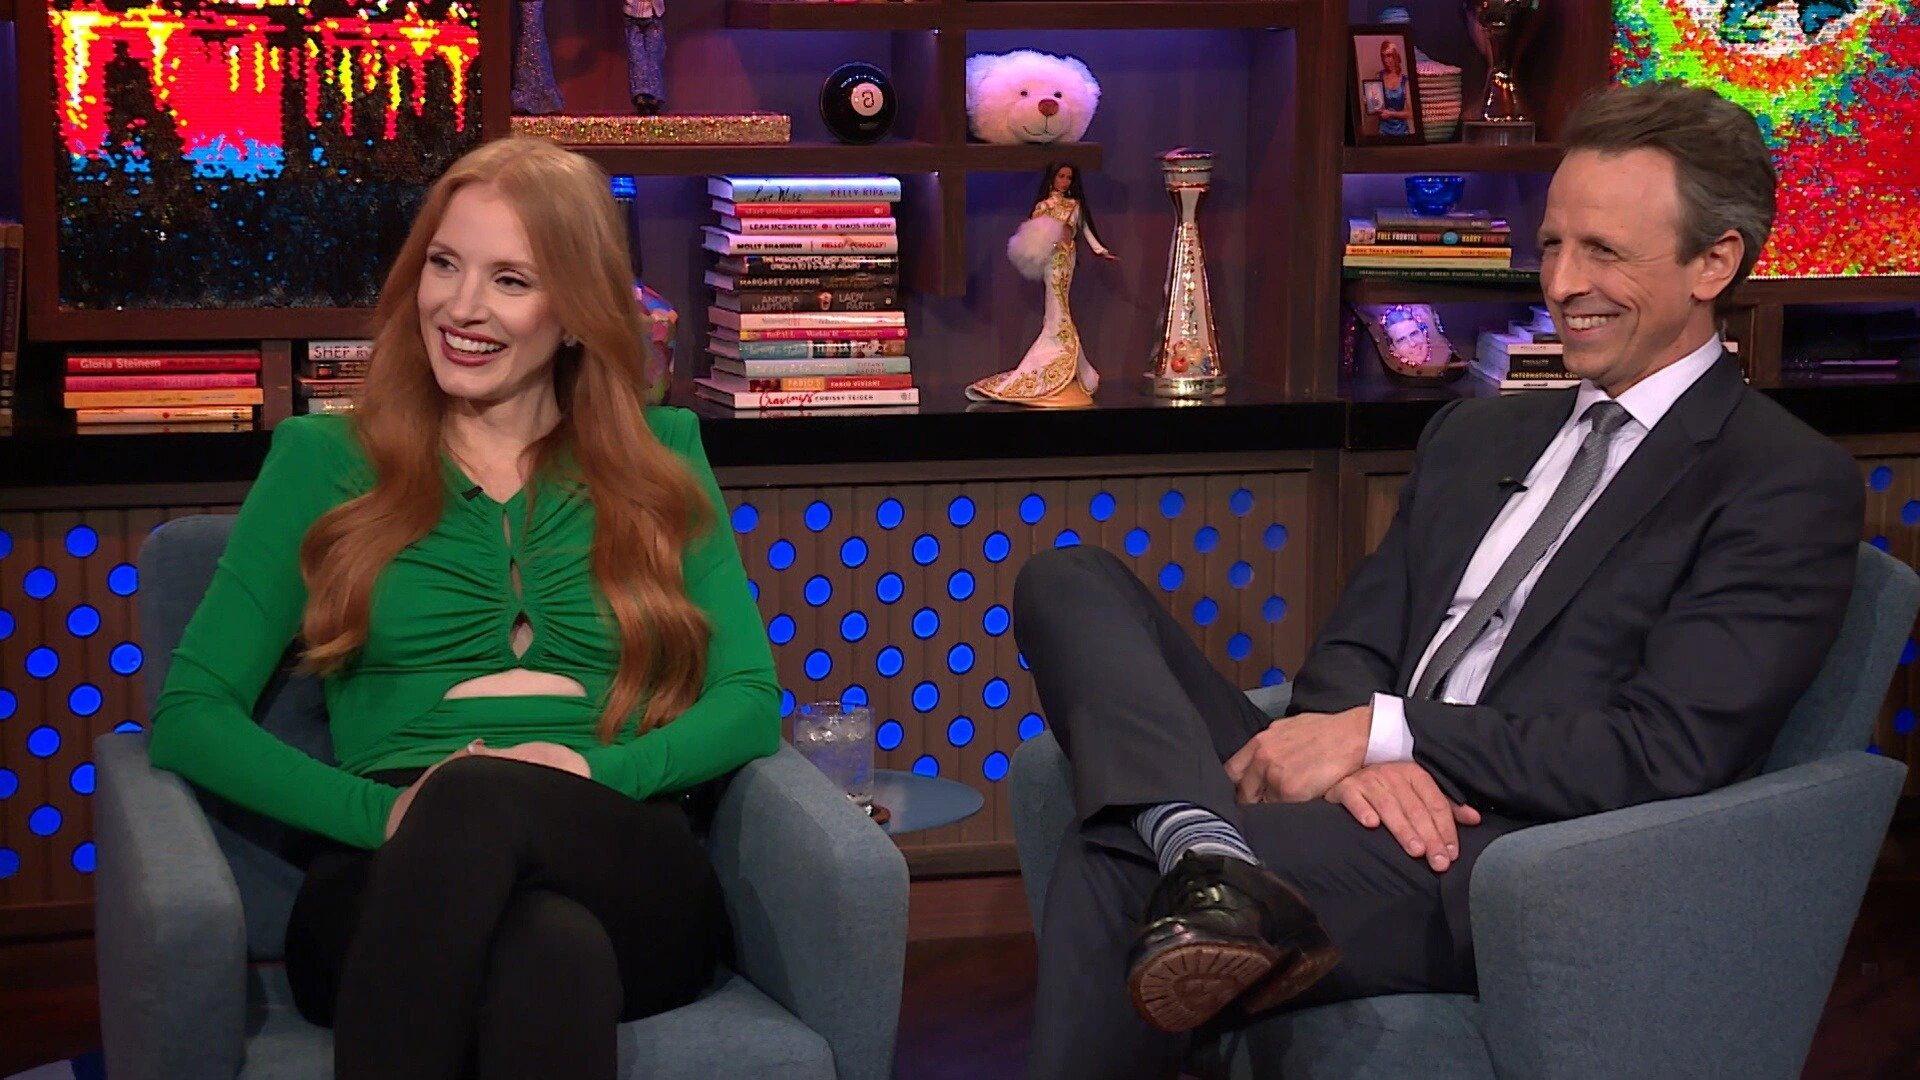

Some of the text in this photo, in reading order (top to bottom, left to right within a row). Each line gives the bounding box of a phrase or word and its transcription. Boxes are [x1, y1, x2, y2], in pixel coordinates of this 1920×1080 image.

[786, 278, 820, 286] JOSEPHS
[838, 292, 864, 303] LADY
[846, 302, 876, 310] PARTS
[314, 346, 350, 358] SHEP
[80, 358, 161, 369] Gloria Steinem
